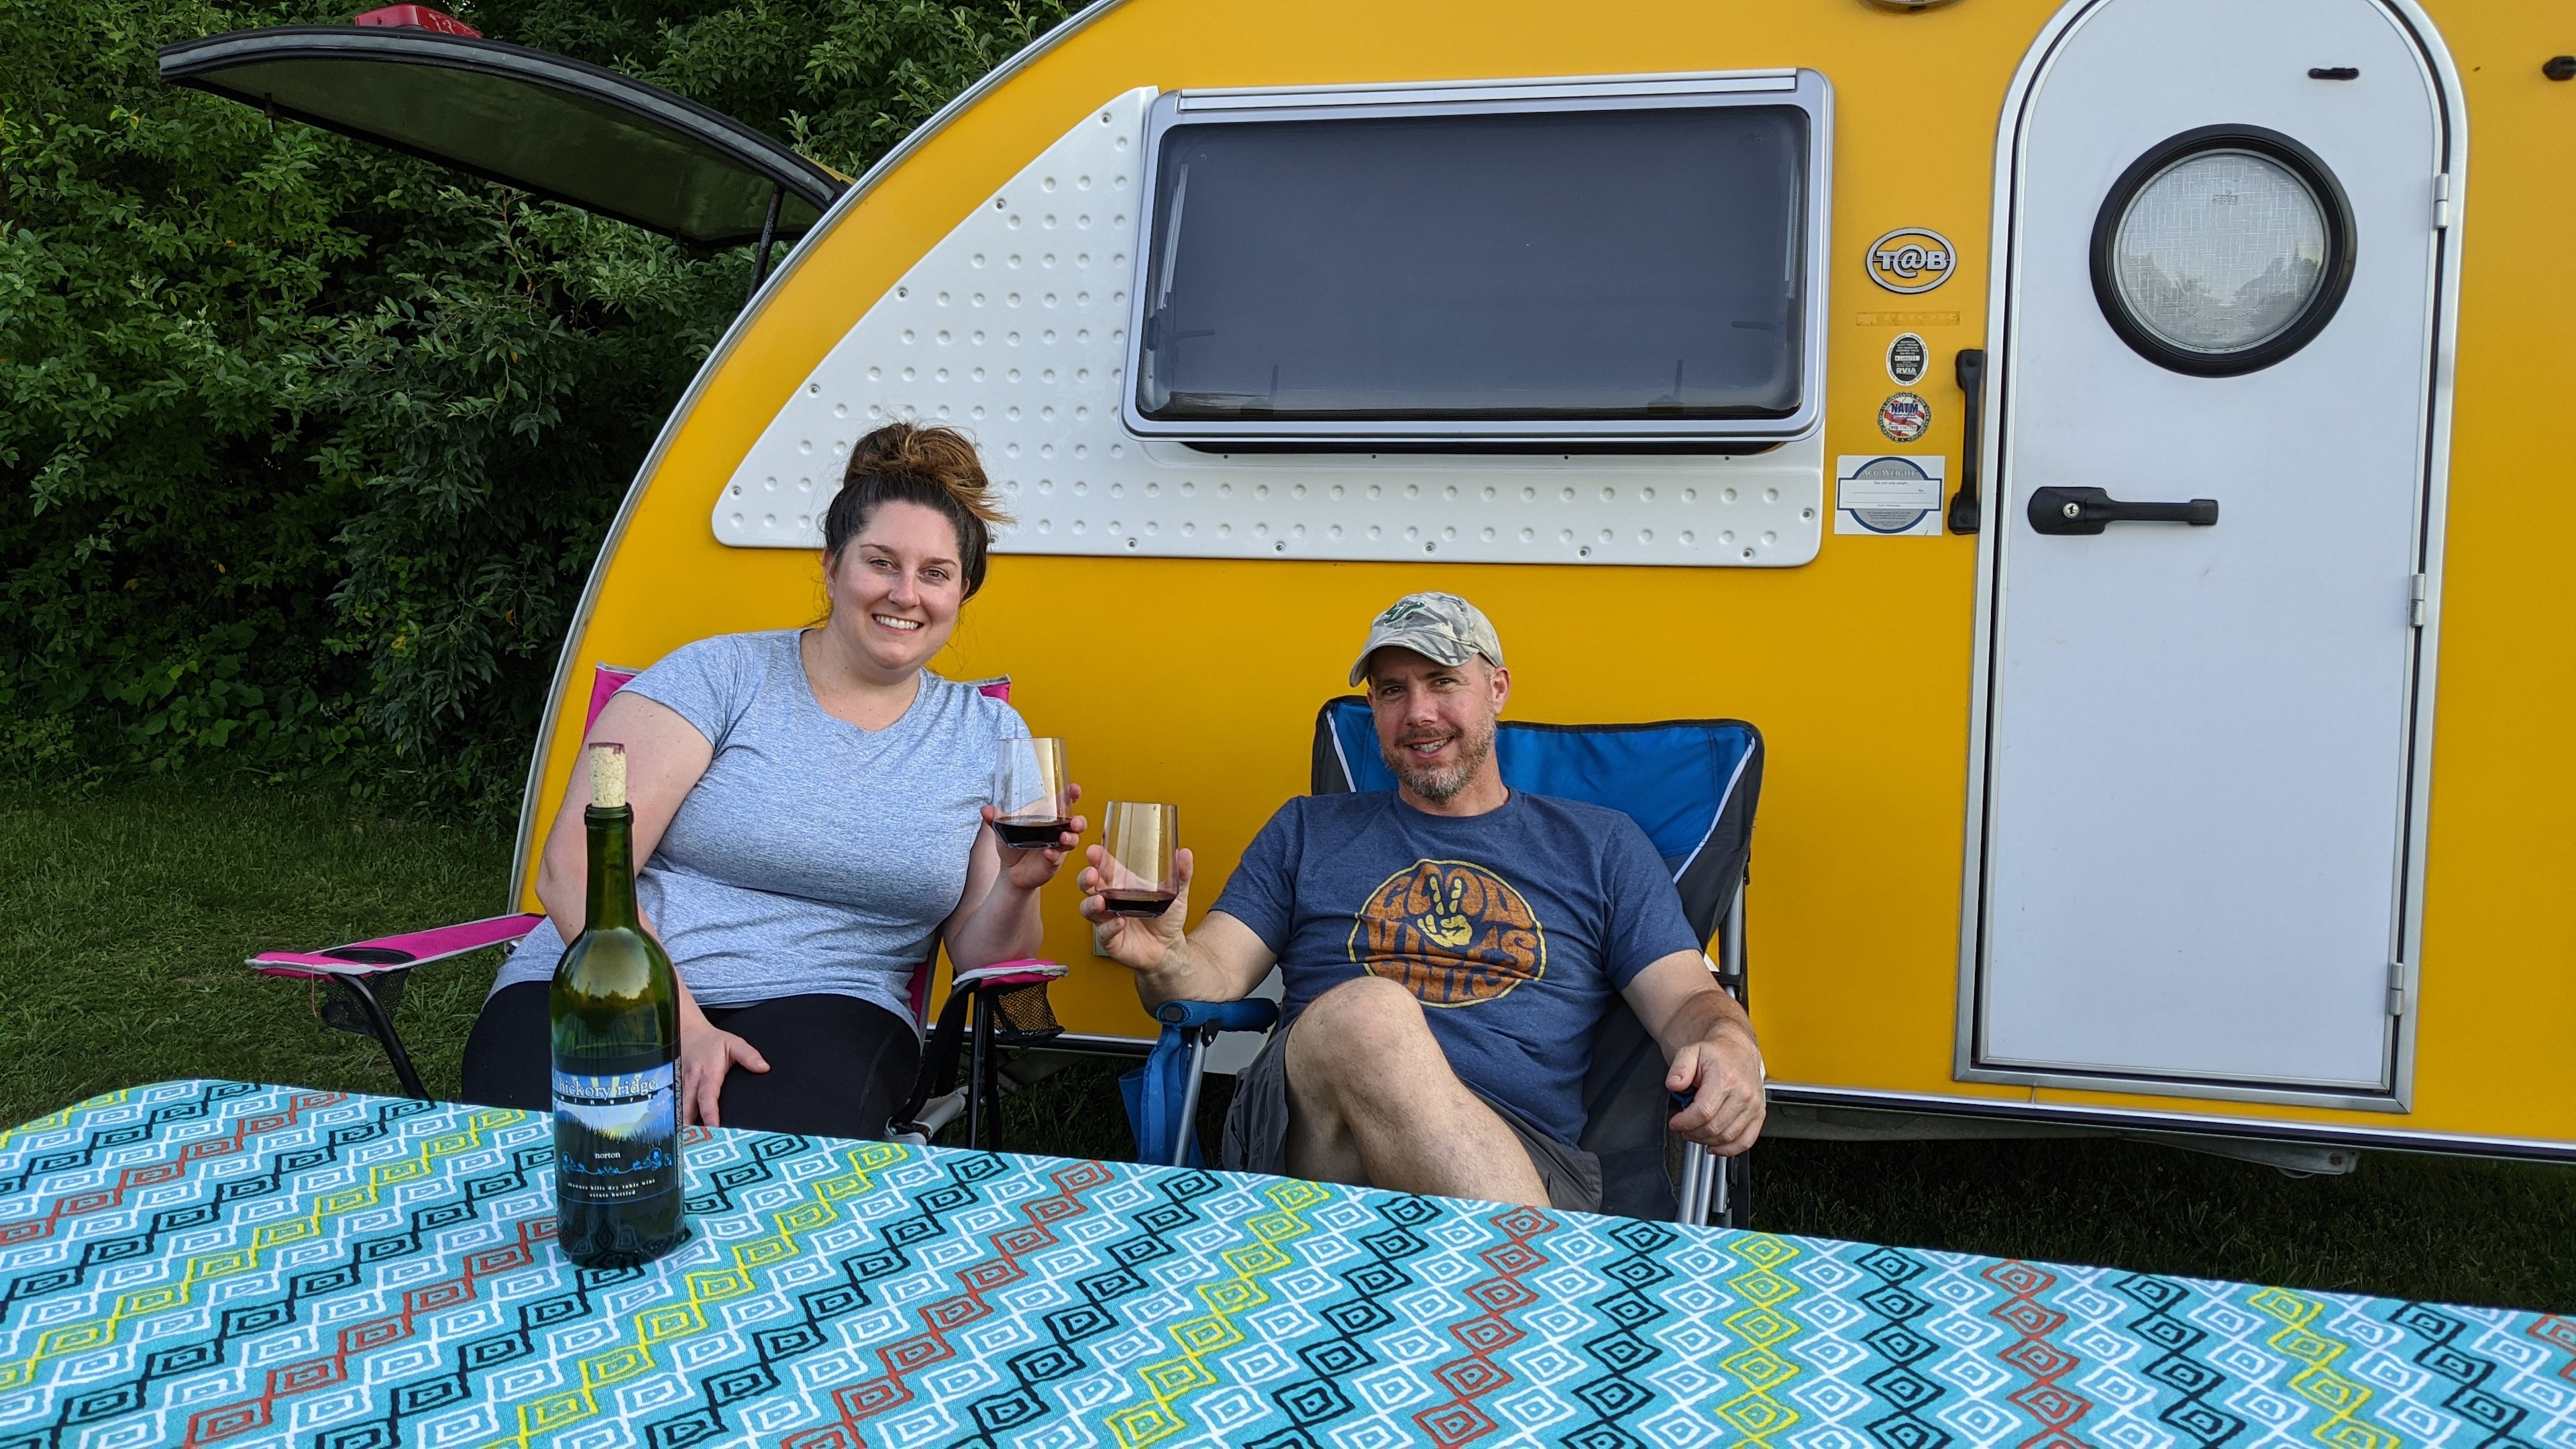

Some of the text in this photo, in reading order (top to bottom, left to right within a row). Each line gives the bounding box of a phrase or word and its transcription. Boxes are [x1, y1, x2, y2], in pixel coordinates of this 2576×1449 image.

[1874, 244, 1948, 278] T@B
[1891, 402, 1919, 413] NATM
[1368, 864, 1534, 930] GOOD
[558, 1077, 657, 1099] hickory ridge
[560, 1094, 652, 1106] winery
[594, 1151, 621, 1160] norton
